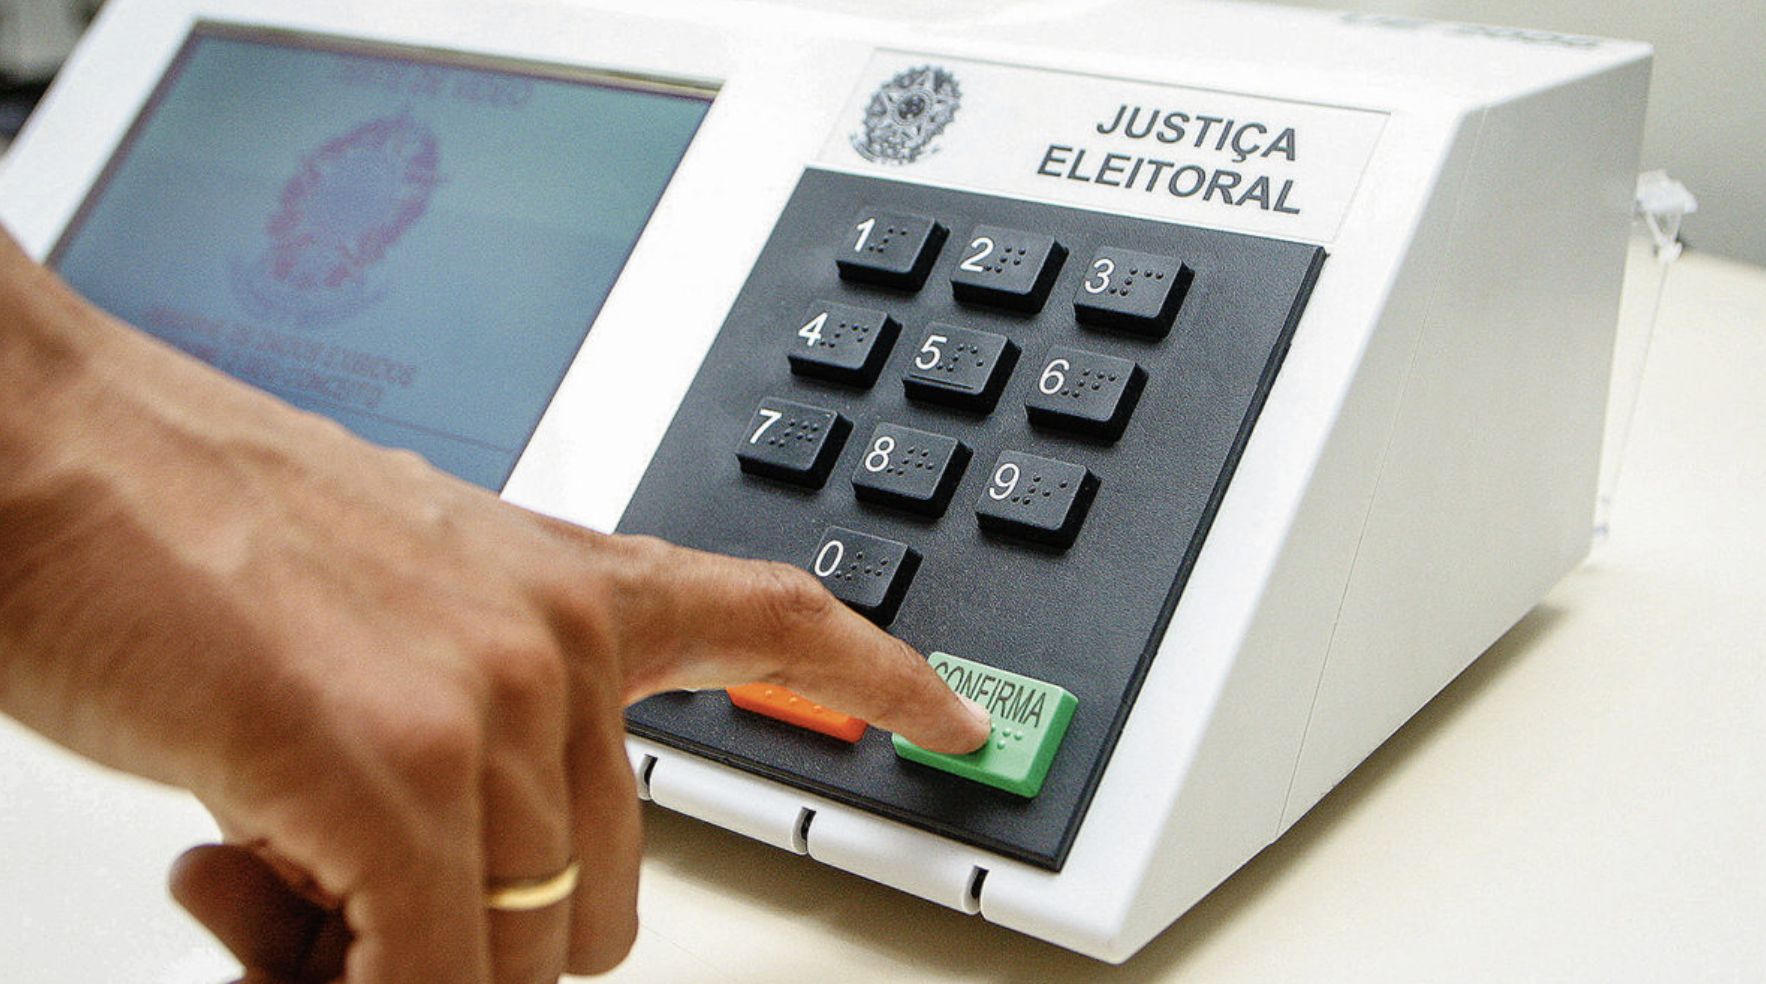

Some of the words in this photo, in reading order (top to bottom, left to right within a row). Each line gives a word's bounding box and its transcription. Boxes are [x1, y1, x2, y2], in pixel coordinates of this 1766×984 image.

[1097, 104, 1296, 163] JUSTIÇA
[1037, 144, 1301, 215] ELEITORAL
[854, 218, 875, 252] 1
[960, 237, 994, 272] 2
[1085, 259, 1114, 293] 3
[798, 313, 828, 347] 4
[915, 335, 947, 369] 5
[1039, 359, 1069, 394] 6
[750, 408, 782, 444] 7
[865, 436, 894, 472] 8
[990, 463, 1020, 500] 9
[815, 540, 843, 576] 0
